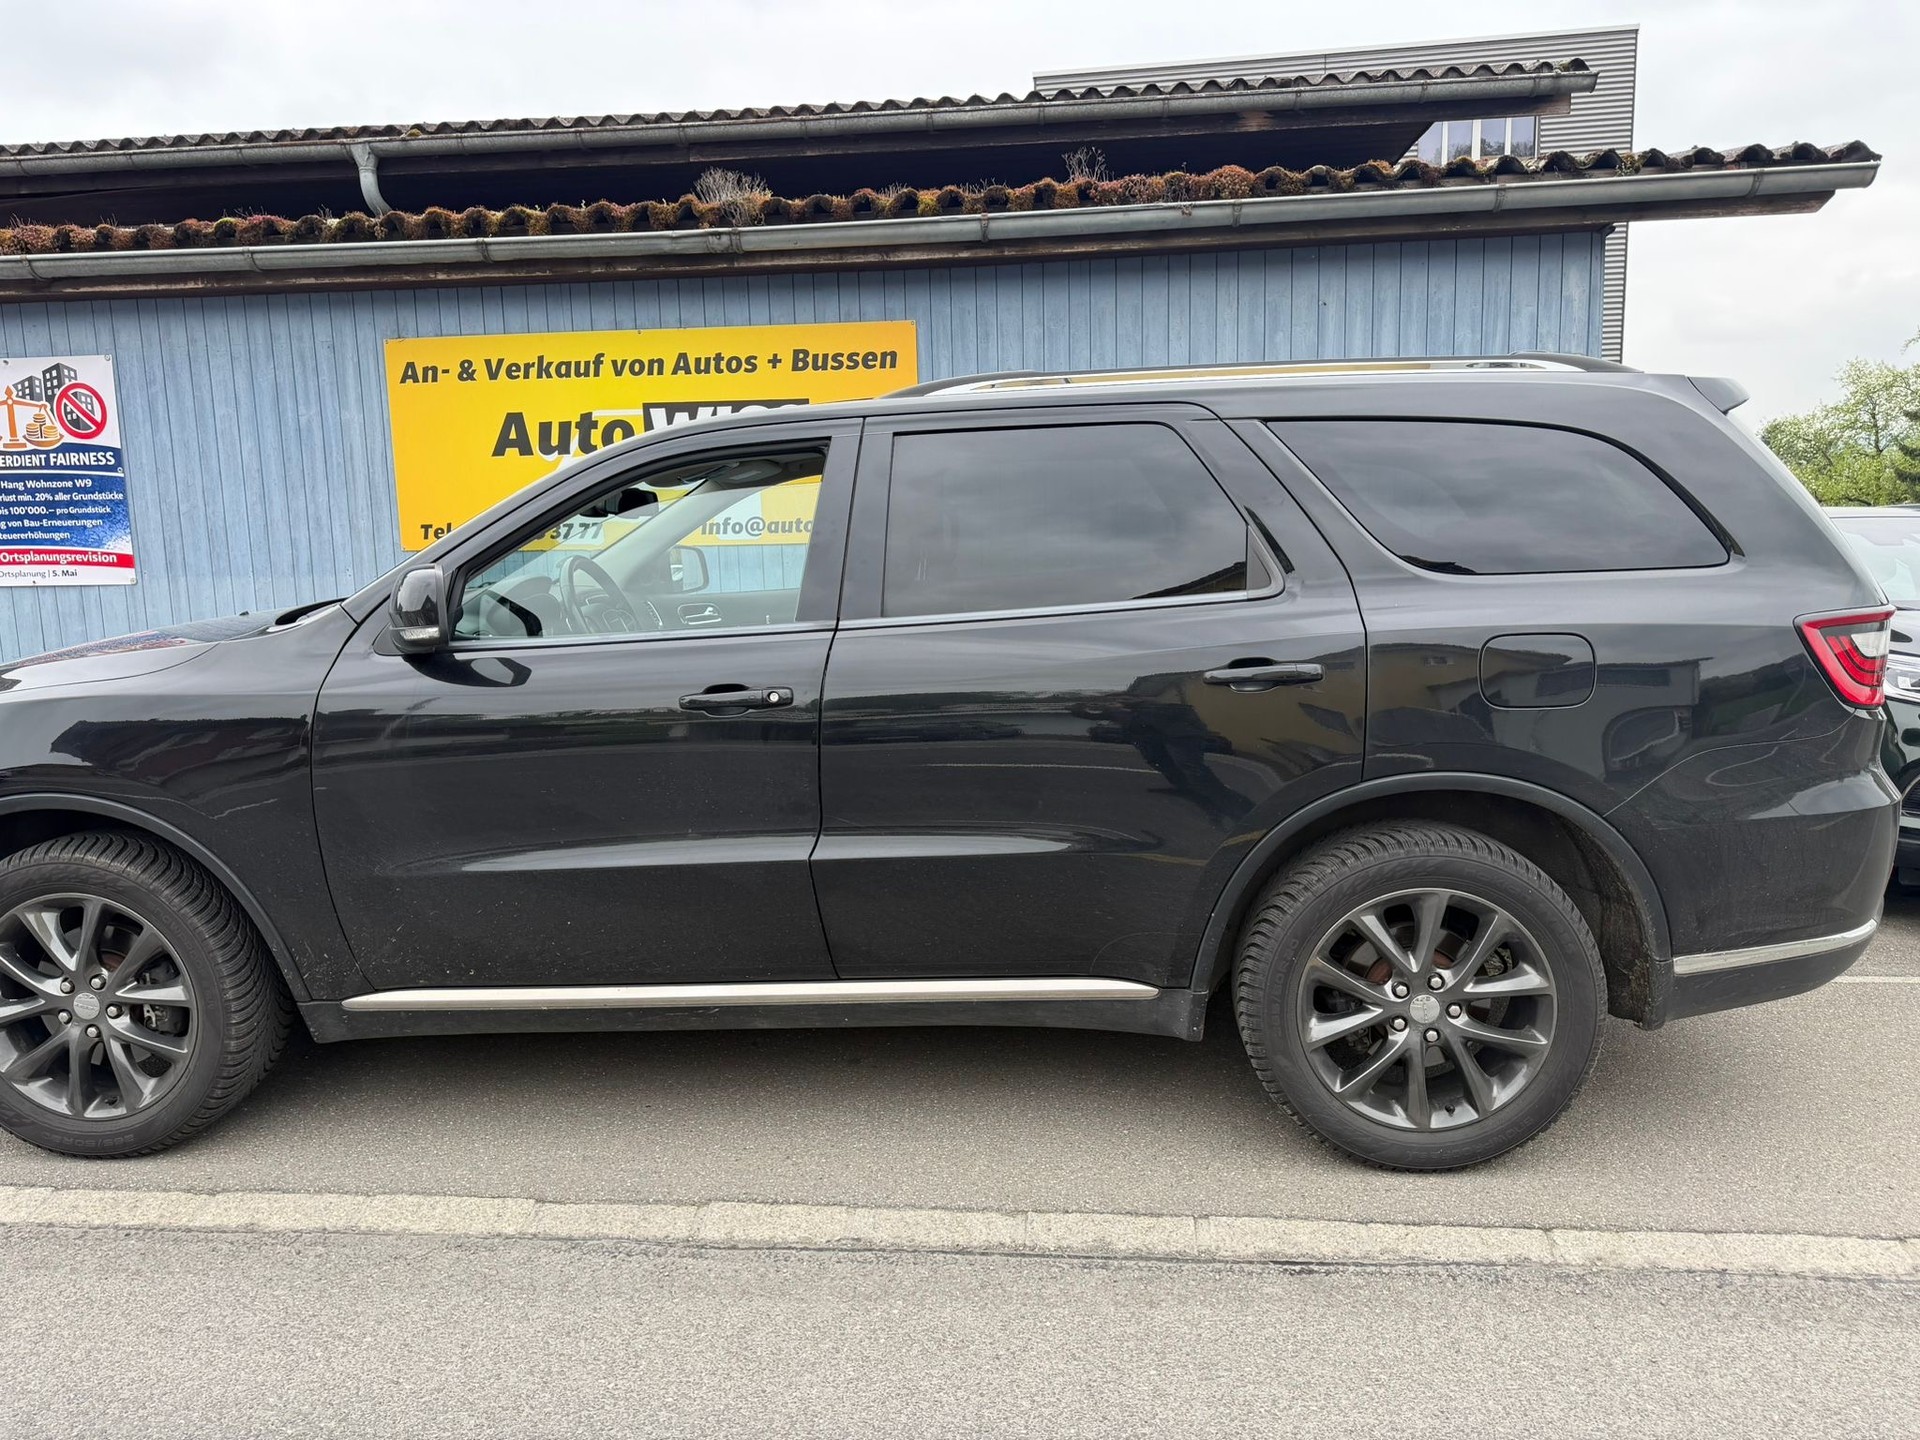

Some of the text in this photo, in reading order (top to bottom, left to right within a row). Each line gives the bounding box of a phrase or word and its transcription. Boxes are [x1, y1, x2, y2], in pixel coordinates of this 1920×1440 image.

[399, 361, 450, 384] An-
[457, 359, 477, 381] &
[484, 353, 605, 380] Verkauf
[611, 357, 665, 377] von
[671, 352, 758, 375] Autos
[791, 349, 898, 372] Bussen
[491, 411, 635, 456] Auto
[49, 451, 115, 466] FAIRNESS
[1, 478, 92, 491] Hang Wohnzone W9
[17, 493, 34, 502] min.
[35, 492, 53, 501] 20%
[54, 492, 71, 501] aller
[72, 491, 124, 500] Grundstücke
[56, 508, 68, 516] pro
[69, 506, 111, 514] Grundstück
[8, 520, 22, 528] von
[23, 519, 103, 529] Bau-Erneuerungen
[0, 551, 117, 564] Ortsplanungsrevision
[61, 569, 78, 577] Mai
